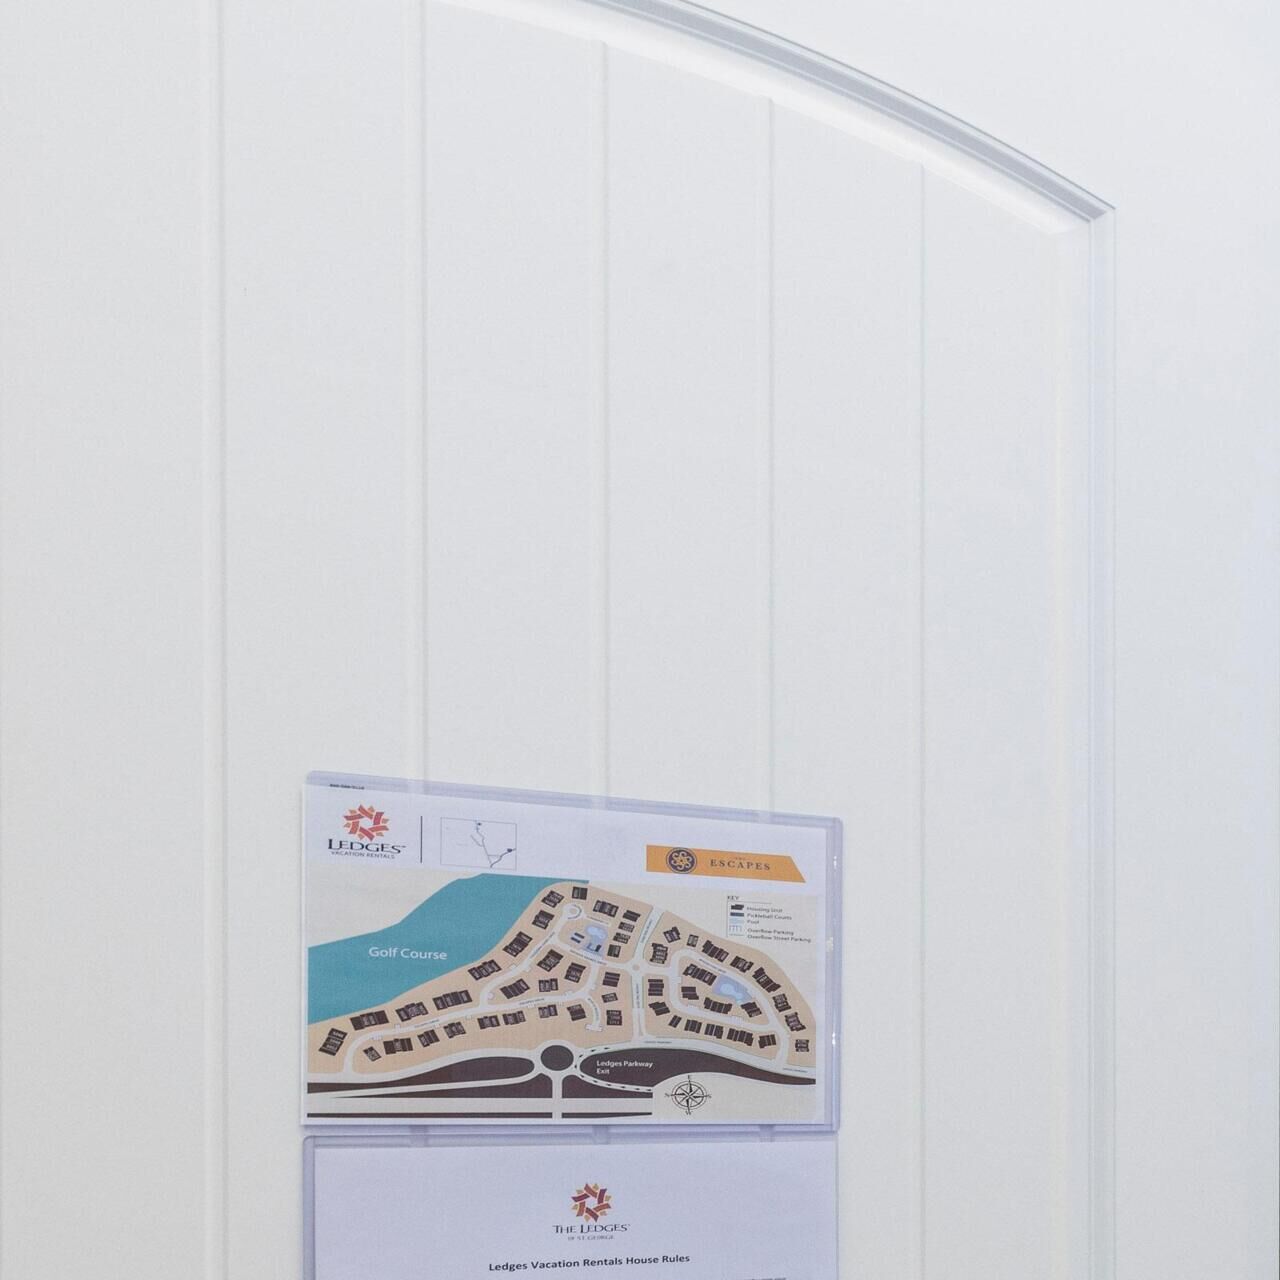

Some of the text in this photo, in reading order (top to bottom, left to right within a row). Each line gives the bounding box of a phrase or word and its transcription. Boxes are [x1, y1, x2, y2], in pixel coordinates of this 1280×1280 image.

[328, 839, 401, 854] LEDGES
[710, 859, 770, 871] ESCAPES
[368, 946, 448, 961] Golf Course
[596, 1060, 654, 1069] Ledges Parkway
[552, 1224, 628, 1234] THE LEDGES
[488, 1254, 691, 1272] Ledges Vacation Rentals House Rules
